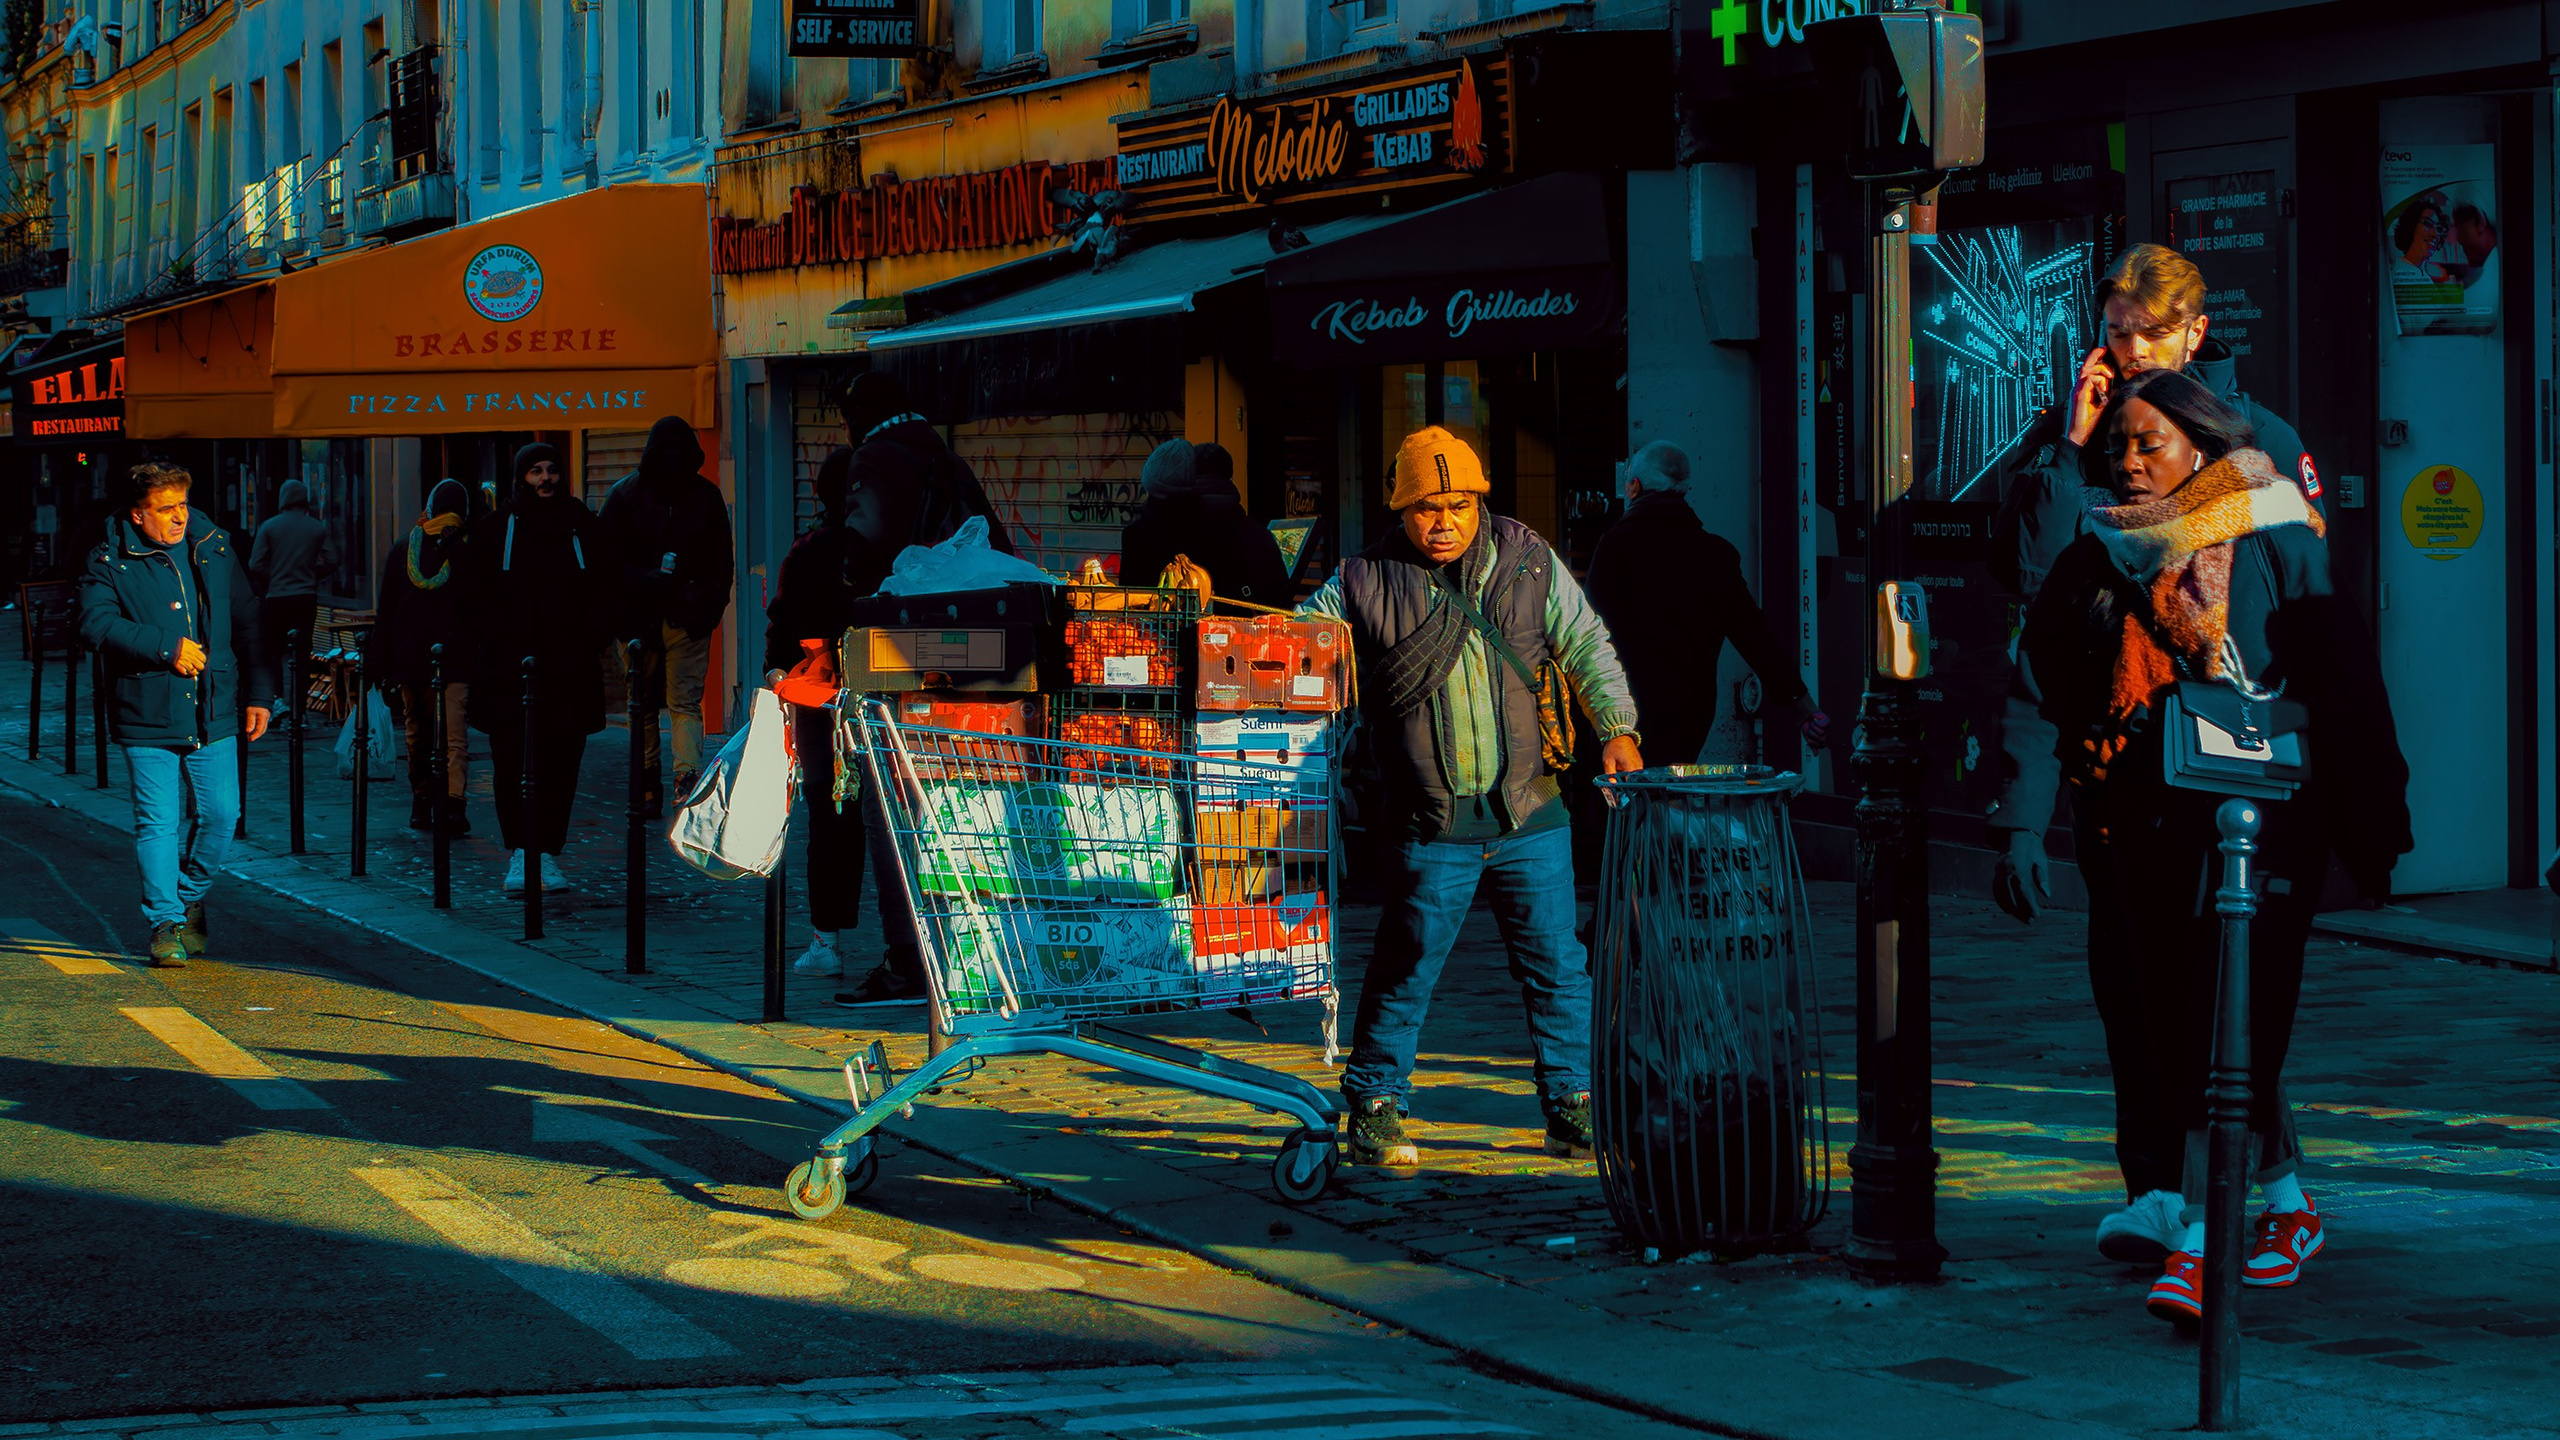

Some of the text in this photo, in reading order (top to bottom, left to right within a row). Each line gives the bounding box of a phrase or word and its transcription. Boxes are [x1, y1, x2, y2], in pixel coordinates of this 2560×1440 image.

[797, 18, 832, 44] SELF
[848, 20, 913, 45] SERVICE
[1354, 82, 1450, 128] GRILLADES
[1117, 97, 1349, 203] RESTAURANT Melodie
[1373, 131, 1433, 168] KEBAB
[2385, 151, 2412, 162] teva
[1941, 162, 2093, 195] elcome Hoş geldiniz Welkom
[2181, 191, 2267, 213] GRANDE PHARMACIE
[791, 187, 867, 265] DELICE
[872, 163, 1032, 257] DEGUSTATION
[2214, 216, 2233, 230] de la
[2184, 232, 2265, 253] PORTE SAINT-DENIS
[470, 248, 537, 277] URFA DURUM
[2223, 288, 2246, 302] AMAR
[1311, 288, 1579, 344] Kebab Grillades
[1951, 291, 2007, 350] PHARMACIE
[2225, 305, 2263, 320] Pharmacie
[394, 328, 617, 357] BRASSERIE
[2223, 325, 2248, 340] équipe
[348, 390, 648, 415] PIZZA FRANÇAISE
[32, 416, 121, 436] RESTAURANT
[1799, 212, 1811, 667] TAX FREE TAX FREE
[1836, 401, 1846, 506] Benvenido
[1940, 521, 1972, 537] ברוכים
[1845, 571, 1860, 583] Nous
[1935, 577, 1949, 589] pour
[1949, 575, 1965, 587] toute
[1241, 717, 1283, 730] Suemi
[1240, 766, 1281, 779] Suemi
[1020, 807, 1066, 829] BIO
[1031, 843, 1053, 854] SCB
[1048, 924, 1093, 944] BIO
[1059, 959, 1081, 970] SCB
